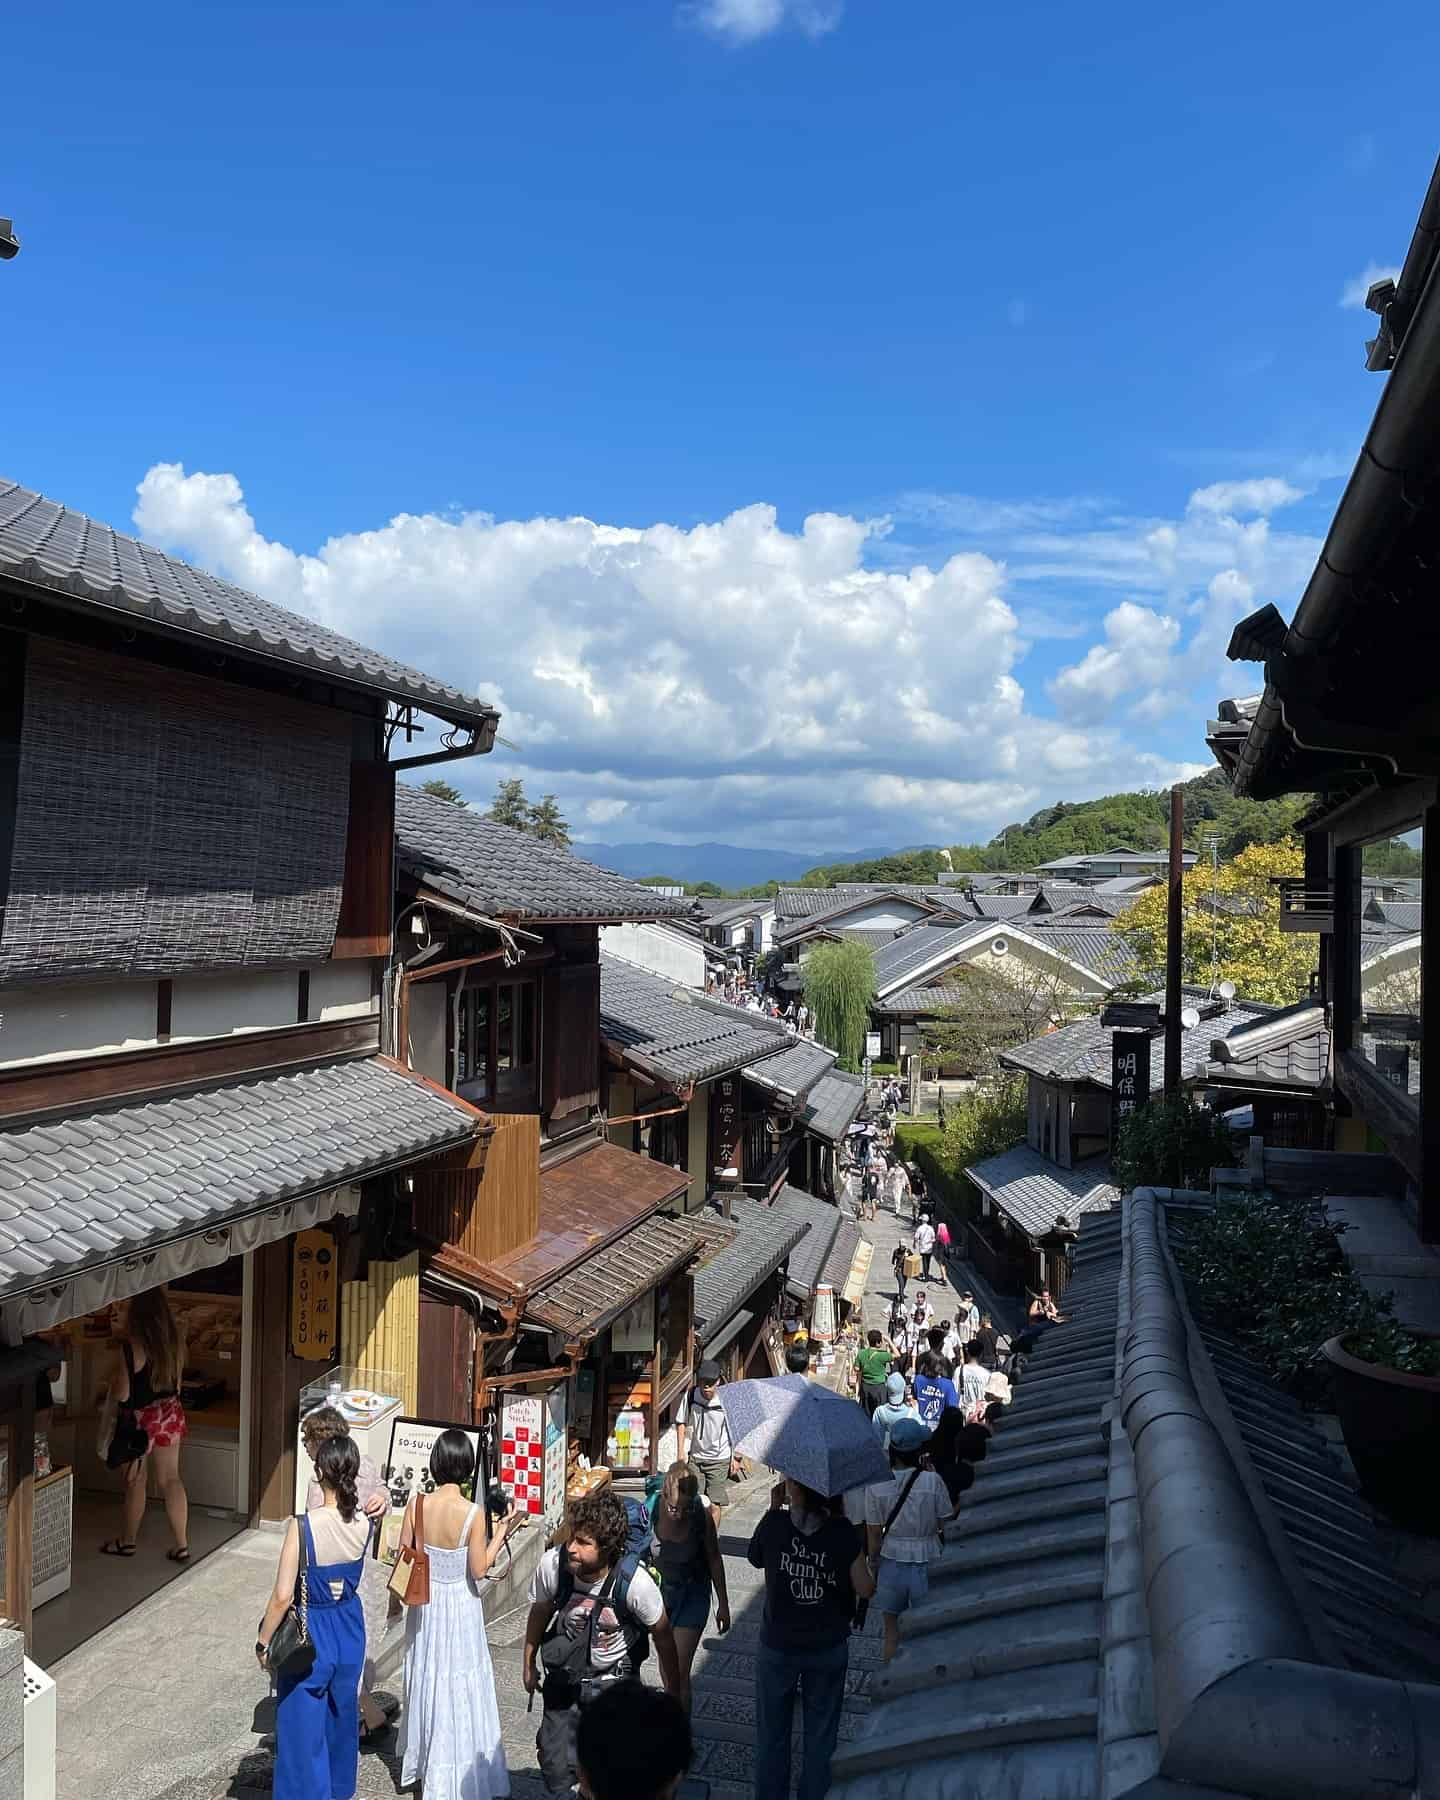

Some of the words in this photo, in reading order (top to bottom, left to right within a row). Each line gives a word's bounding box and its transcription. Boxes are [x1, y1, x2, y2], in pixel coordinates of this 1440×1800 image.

[791, 1536, 826, 1567] Saint
[779, 1551, 837, 1587] Running
[790, 1578, 824, 1599] Club
